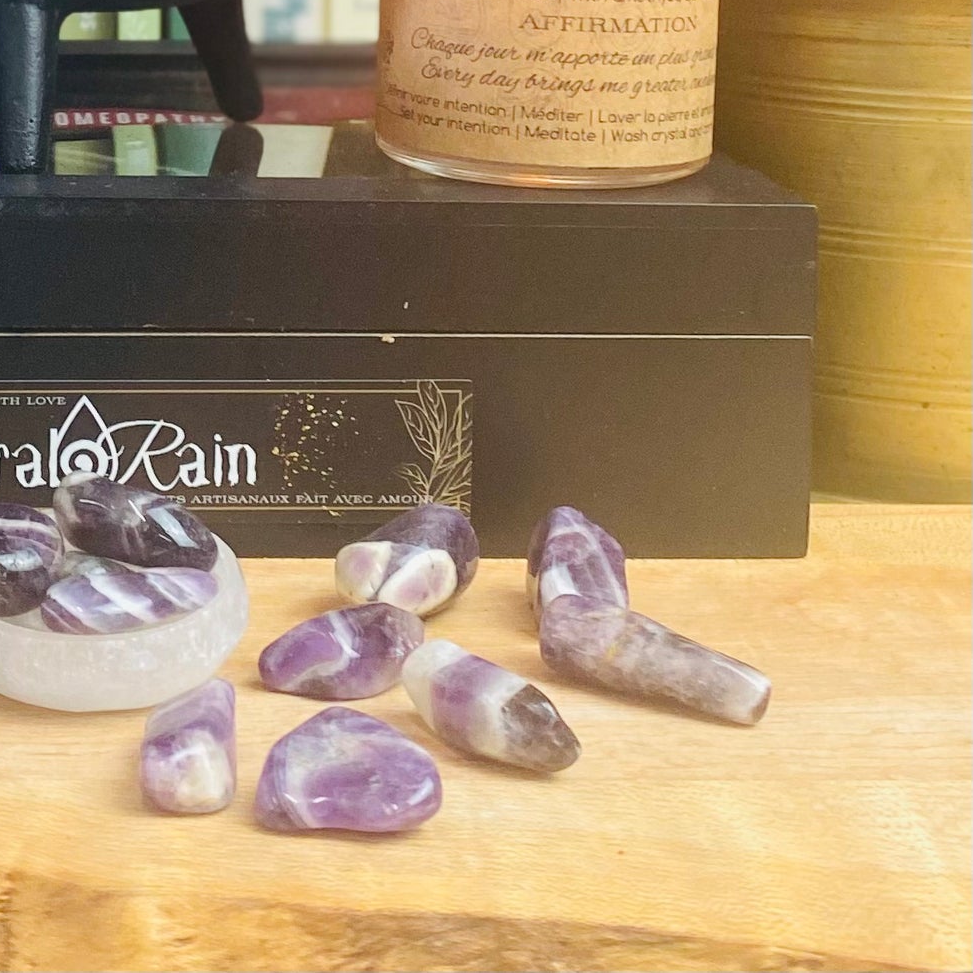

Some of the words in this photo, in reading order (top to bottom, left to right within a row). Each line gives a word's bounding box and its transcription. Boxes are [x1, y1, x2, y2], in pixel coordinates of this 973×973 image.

[518, 13, 698, 34] AFFIRMATION
[410, 26, 475, 60] Chaque
[472, 42, 521, 63] jour
[421, 56, 476, 89] Every
[479, 70, 521, 94] day
[524, 73, 595, 99] brings
[599, 81, 629, 94] me
[53, 111, 227, 126] OMEOPATHY
[410, 92, 441, 108] votre
[443, 98, 507, 118] intention
[520, 105, 584, 123] Méditer
[598, 109, 642, 124] Laver
[643, 109, 656, 124] la
[657, 110, 690, 126] pierre
[418, 113, 444, 127] your
[446, 116, 510, 136] intention
[524, 125, 597, 142] Meditate
[611, 129, 649, 143] Wash
[651, 127, 687, 145] crystal
[27, 396, 67, 407] LOVE
[99, 418, 257, 492] Rain
[191, 494, 289, 504] ARTISANAUX
[296, 494, 328, 504] FAIT
[333, 494, 373, 505] AVEC
